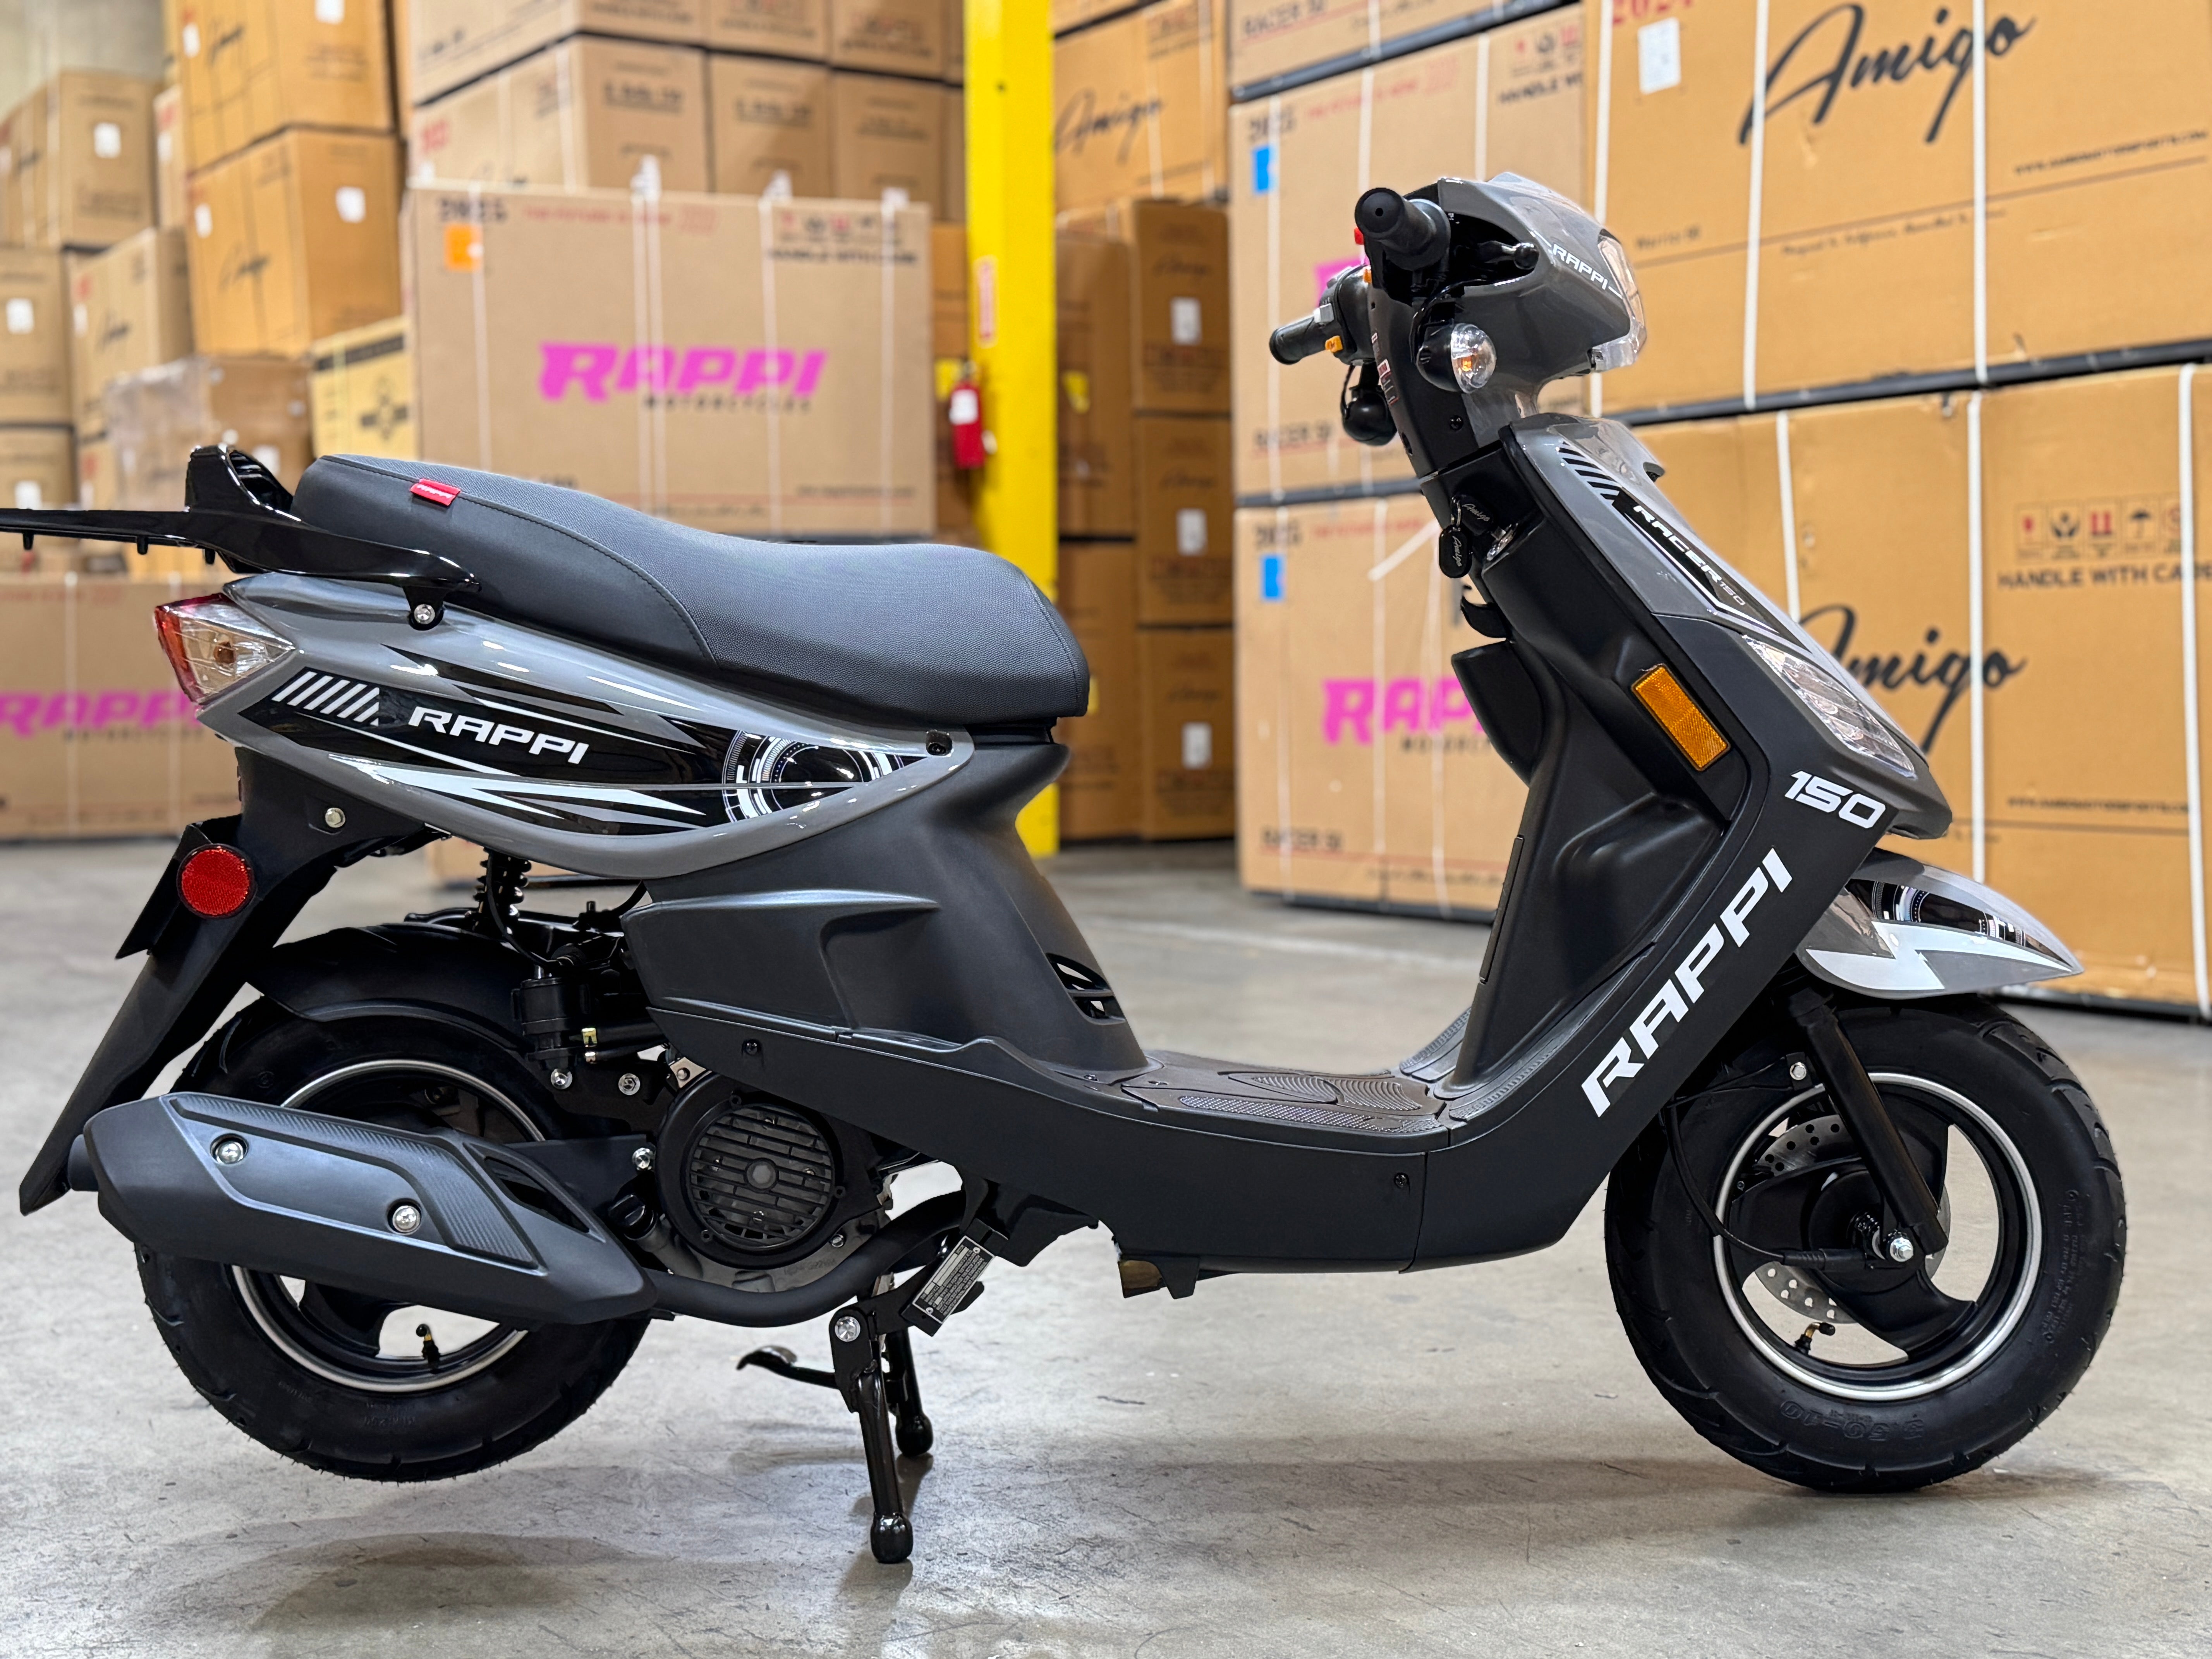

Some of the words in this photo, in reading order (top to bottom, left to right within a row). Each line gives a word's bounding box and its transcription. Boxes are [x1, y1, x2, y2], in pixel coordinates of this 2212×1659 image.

[1739, 2, 2036, 145] Amigo
[1552, 243, 1608, 290] RAPPI
[538, 342, 827, 403] RAPPI
[1633, 505, 1722, 583] RACER
[1719, 582, 1746, 606] 150
[1997, 566, 2081, 590] HANDLE
[2094, 562, 2148, 583] WITH
[408, 706, 589, 764] RAPPI
[1784, 771, 1886, 828] 150
[1581, 848, 1793, 1118] RAPPI
